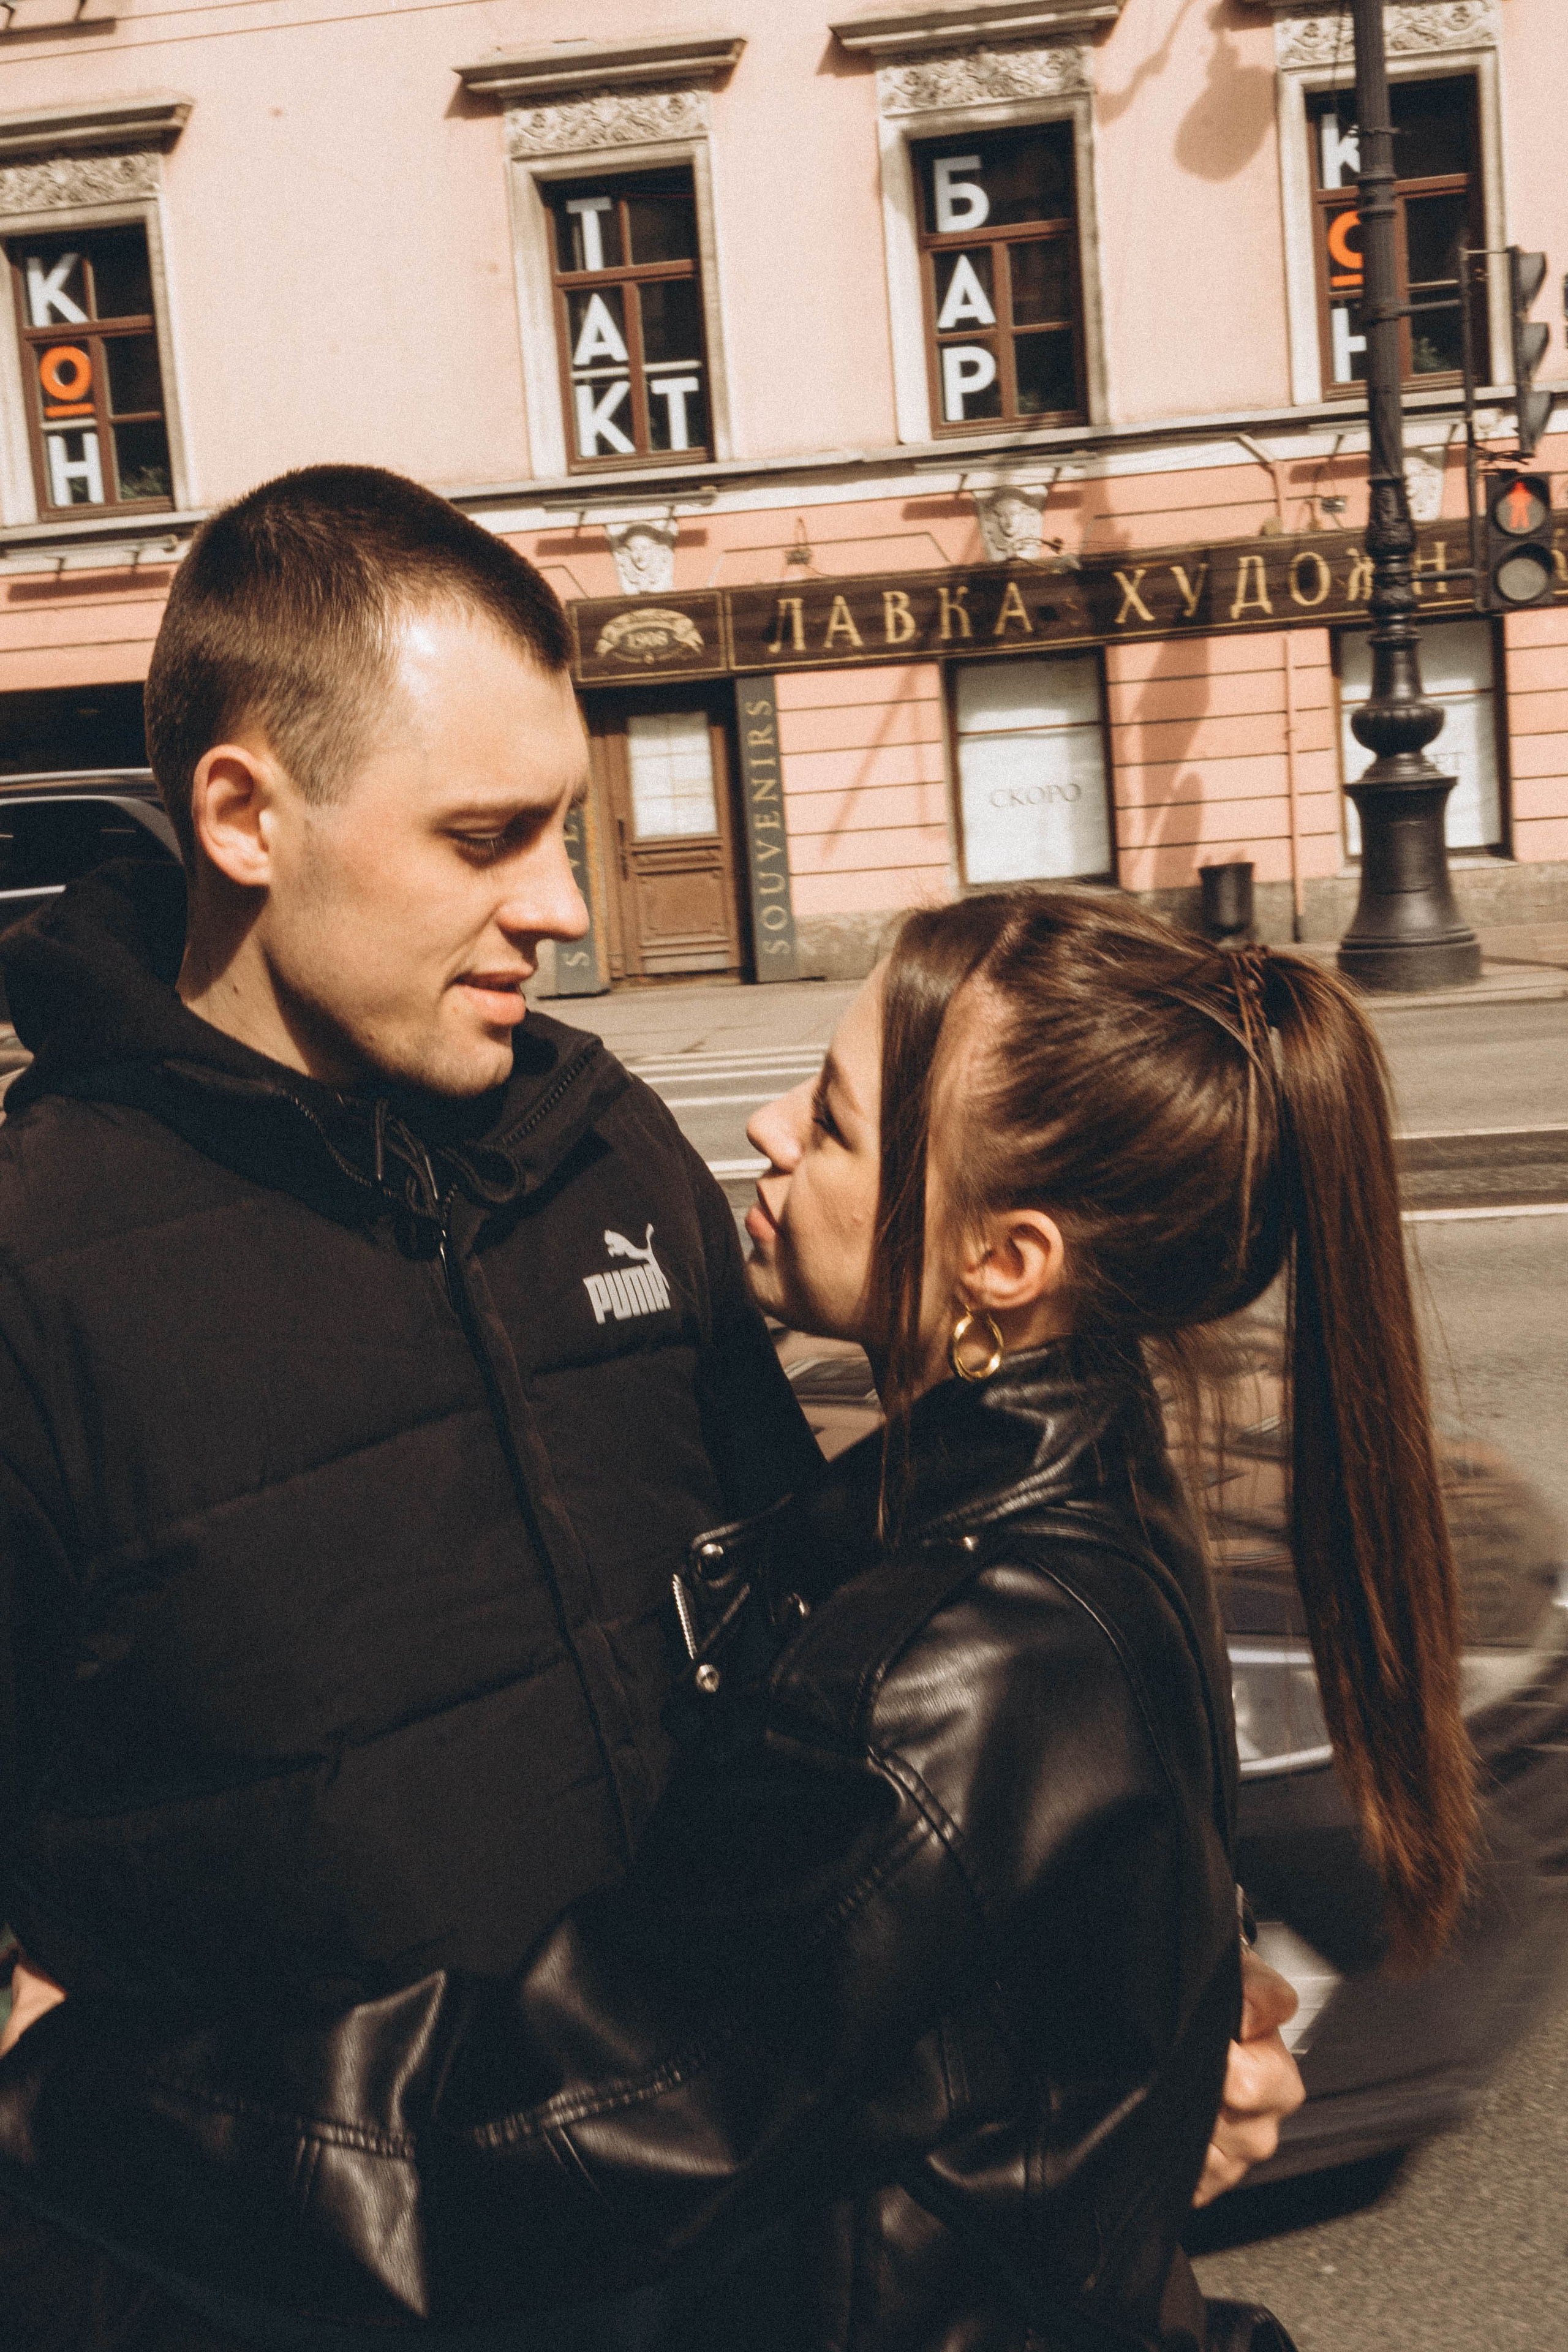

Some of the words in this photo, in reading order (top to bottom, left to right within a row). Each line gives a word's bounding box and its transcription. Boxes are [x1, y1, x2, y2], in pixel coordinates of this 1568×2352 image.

[933, 154, 997, 423] БАР
[26, 252, 105, 507] КОН
[767, 581, 1033, 654] ЛАВКА
[745, 699, 793, 956] SOUVENIRS
[988, 782, 1082, 808] СКОРО
[582, 1262, 671, 1325] PUMA
